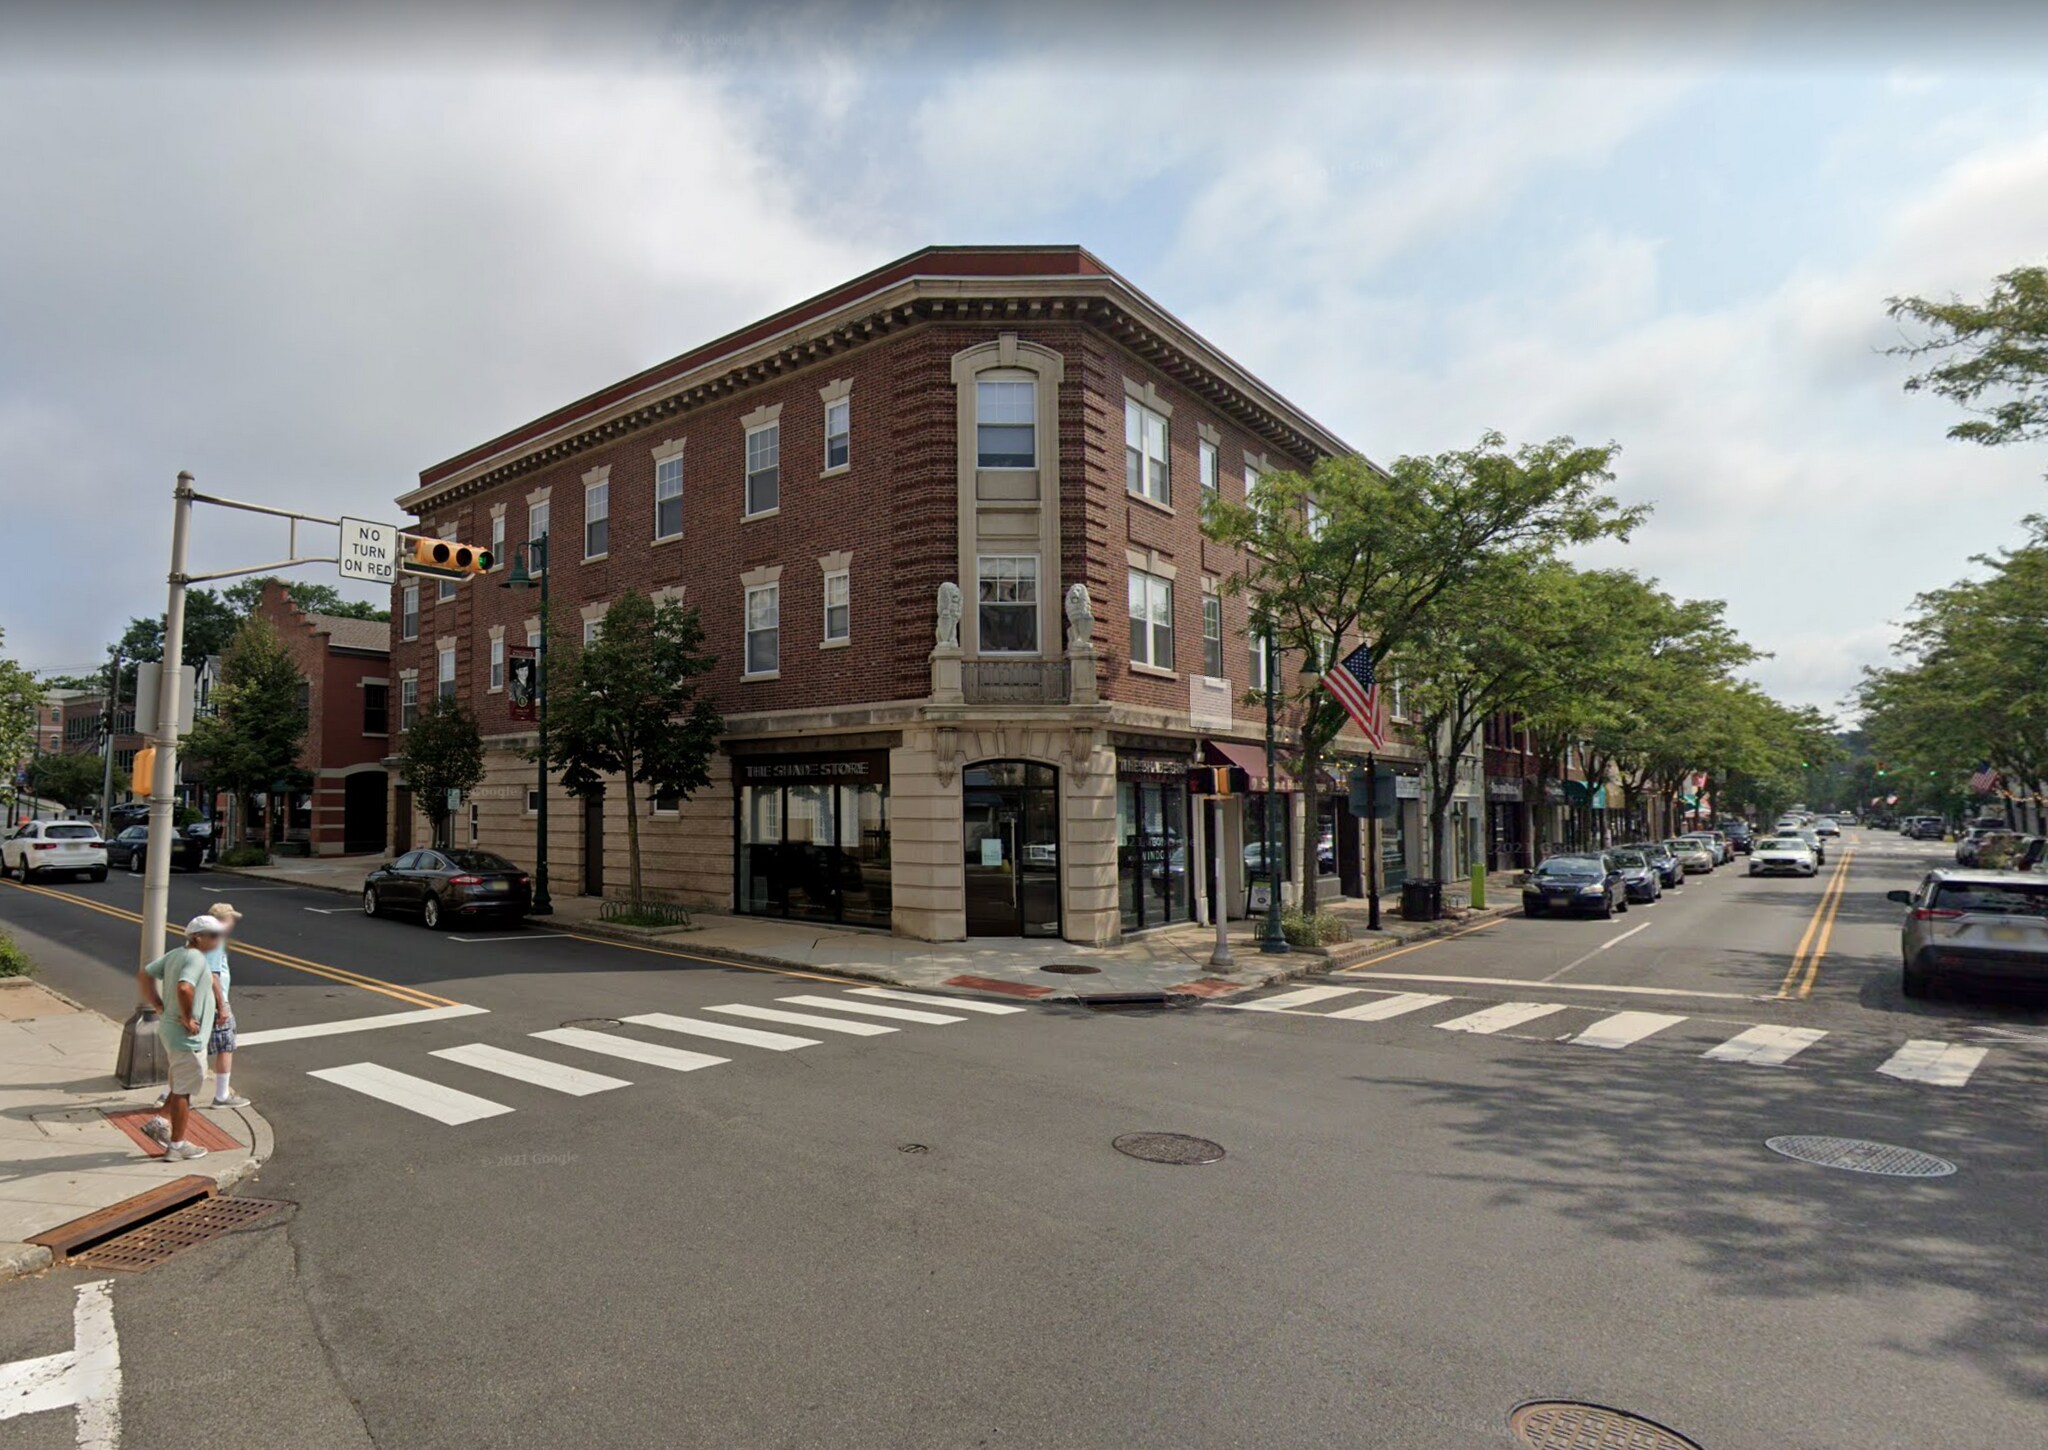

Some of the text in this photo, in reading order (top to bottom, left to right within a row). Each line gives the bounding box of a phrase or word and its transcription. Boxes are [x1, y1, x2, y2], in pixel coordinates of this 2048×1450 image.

[359, 527, 381, 542] NO
[352, 543, 386, 559] TURN
[344, 558, 392, 577] ON RED
[745, 761, 869, 778] THE SHADE STORE
